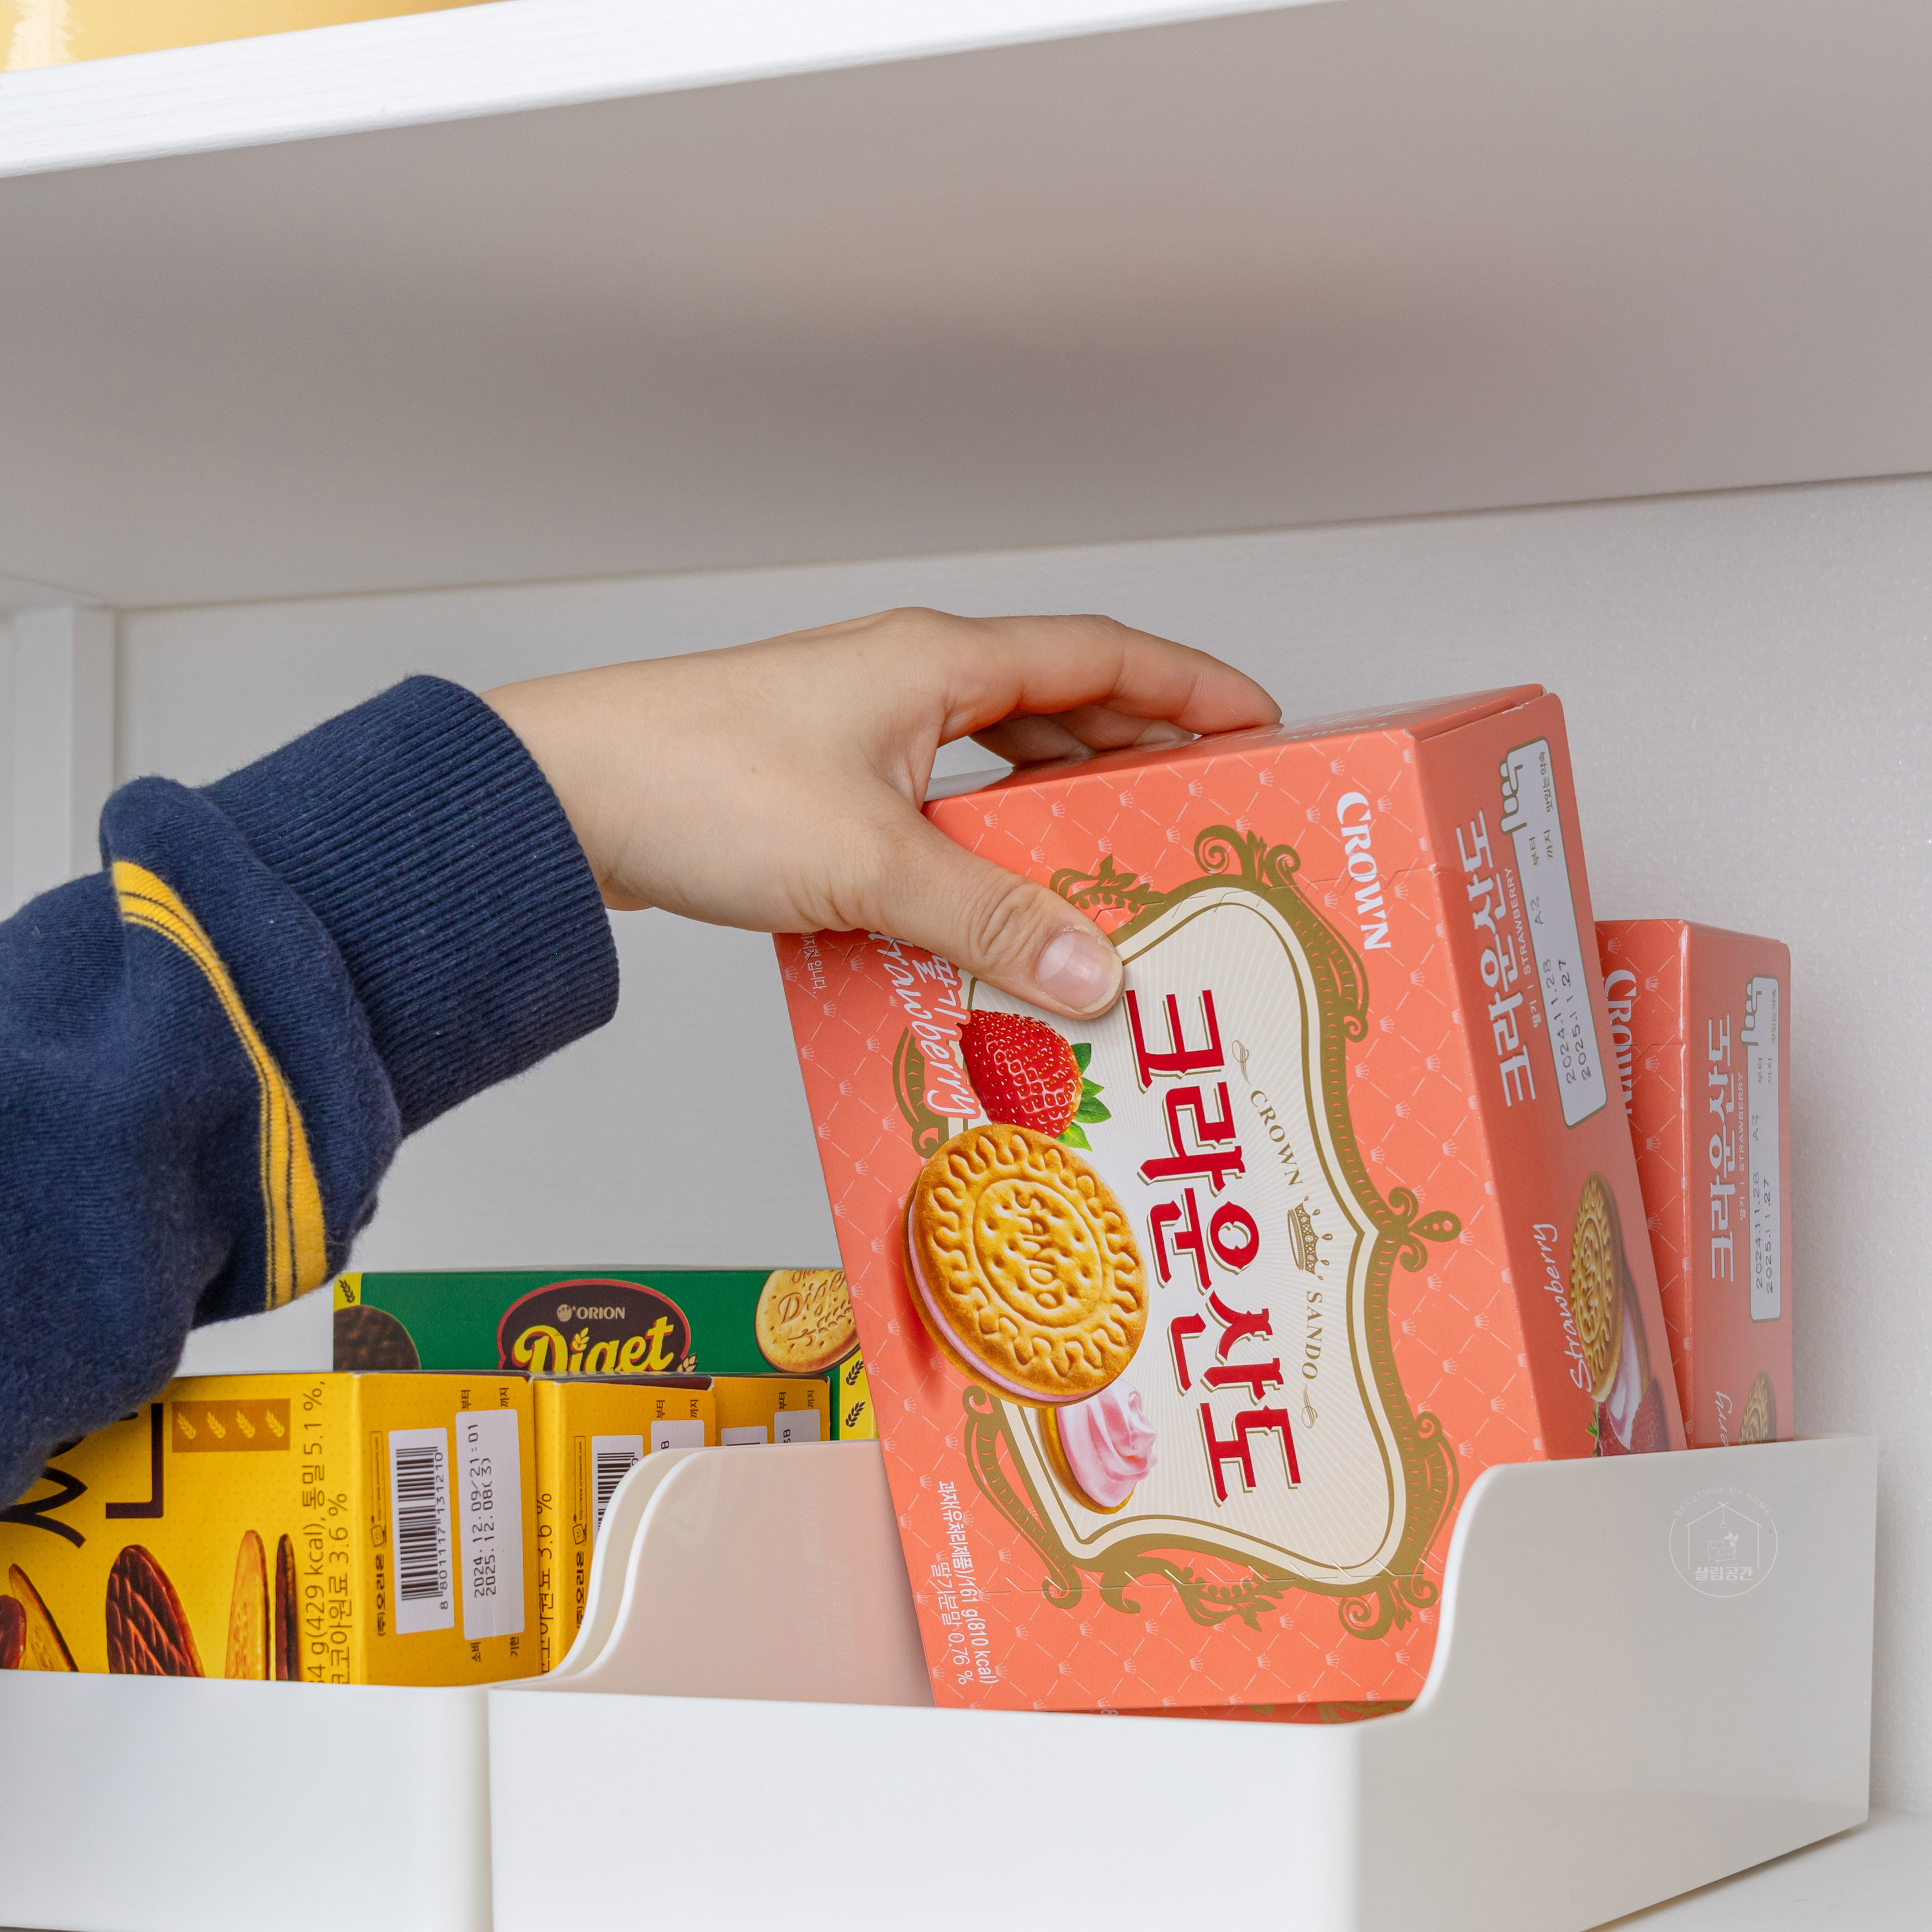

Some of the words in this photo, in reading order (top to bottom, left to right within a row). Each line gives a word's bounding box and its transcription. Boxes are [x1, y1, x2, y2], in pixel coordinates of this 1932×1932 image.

[1528, 836, 1540, 866] 부터
[1543, 829, 1554, 859] 까지
[1336, 792, 1392, 951] CROWN
[1504, 867, 1531, 975] STRAWBERRY
[1456, 809, 1536, 1107] 크라운산도
[911, 955, 967, 1021] 딸기
[868, 932, 976, 1114] trawberry
[1708, 1013, 1736, 1282] 크라운산도
[1124, 989, 1302, 1507] 크라운산도
[1250, 1090, 1303, 1187] CROWN
[1301, 1291, 1323, 1380] SANDO
[576, 1306, 626, 1320] ORION
[1532, 1223, 1593, 1393] Strawberry
[460, 1388, 471, 1410] 부터
[499, 1387, 510, 1408] 까지
[655, 1399, 666, 1419] 부터
[689, 1399, 699, 1419] 까지
[778, 1391, 787, 1410] 부터
[303, 1422, 324, 1456] 5.1
[302, 1464, 326, 1510] 통밀
[1675, 1487, 1724, 1517] BEAUTIFUL
[1746, 1492, 1772, 1516] HOME
[328, 1493, 348, 1517] %
[328, 1527, 349, 1565] 3.6
[1694, 1566, 1754, 1581] 살림공간
[375, 1553, 386, 1637] (주)오리온
[931, 1562, 963, 1626] 딸기분말
[304, 1585, 330, 1655] g(429
[960, 1609, 989, 1646] g(810
[470, 1641, 481, 1663] 소비
[509, 1636, 521, 1657] 기한
[947, 1633, 970, 1666] 0.76
[956, 1670, 975, 1685] %
[974, 1651, 1000, 1684] kcal)
